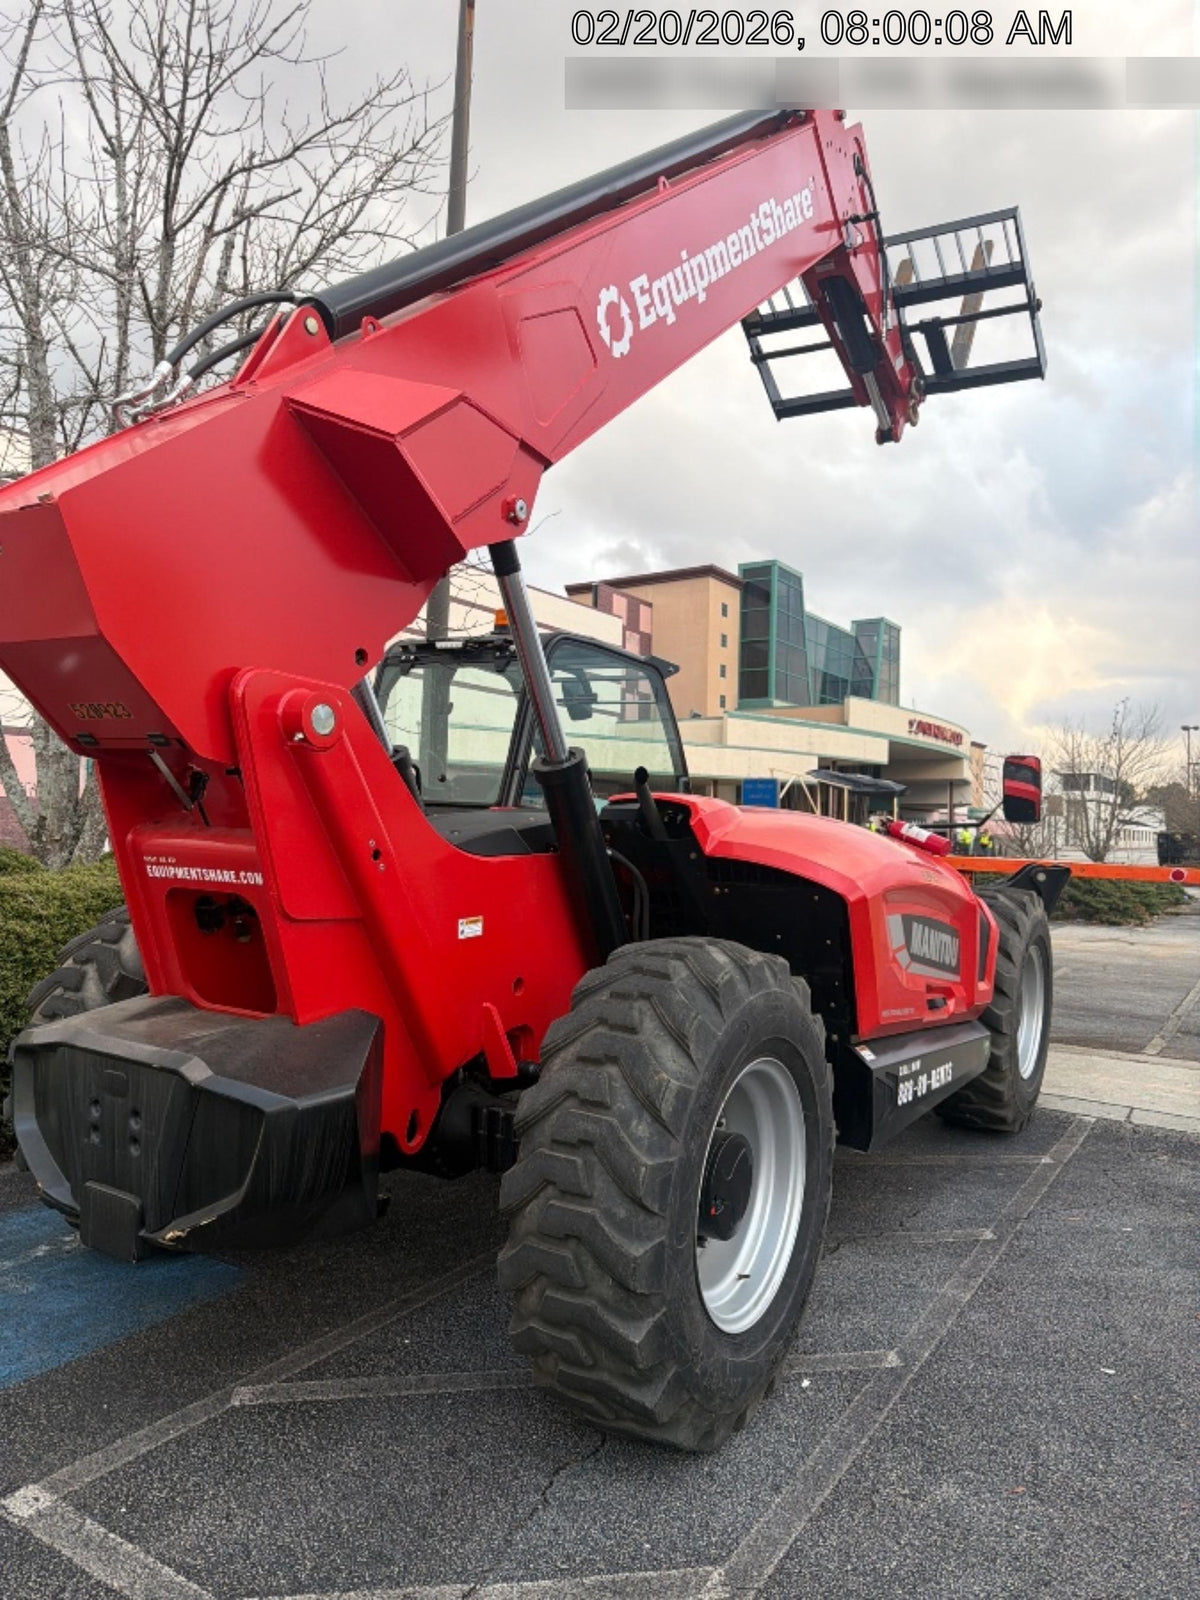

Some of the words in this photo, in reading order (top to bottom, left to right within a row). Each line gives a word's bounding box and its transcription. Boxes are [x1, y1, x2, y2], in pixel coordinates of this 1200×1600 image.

[629, 186, 814, 331] EquipmentShare
[146, 865, 263, 885] EQUIPMENTSHARE.COM
[910, 920, 960, 968] MANITOU
